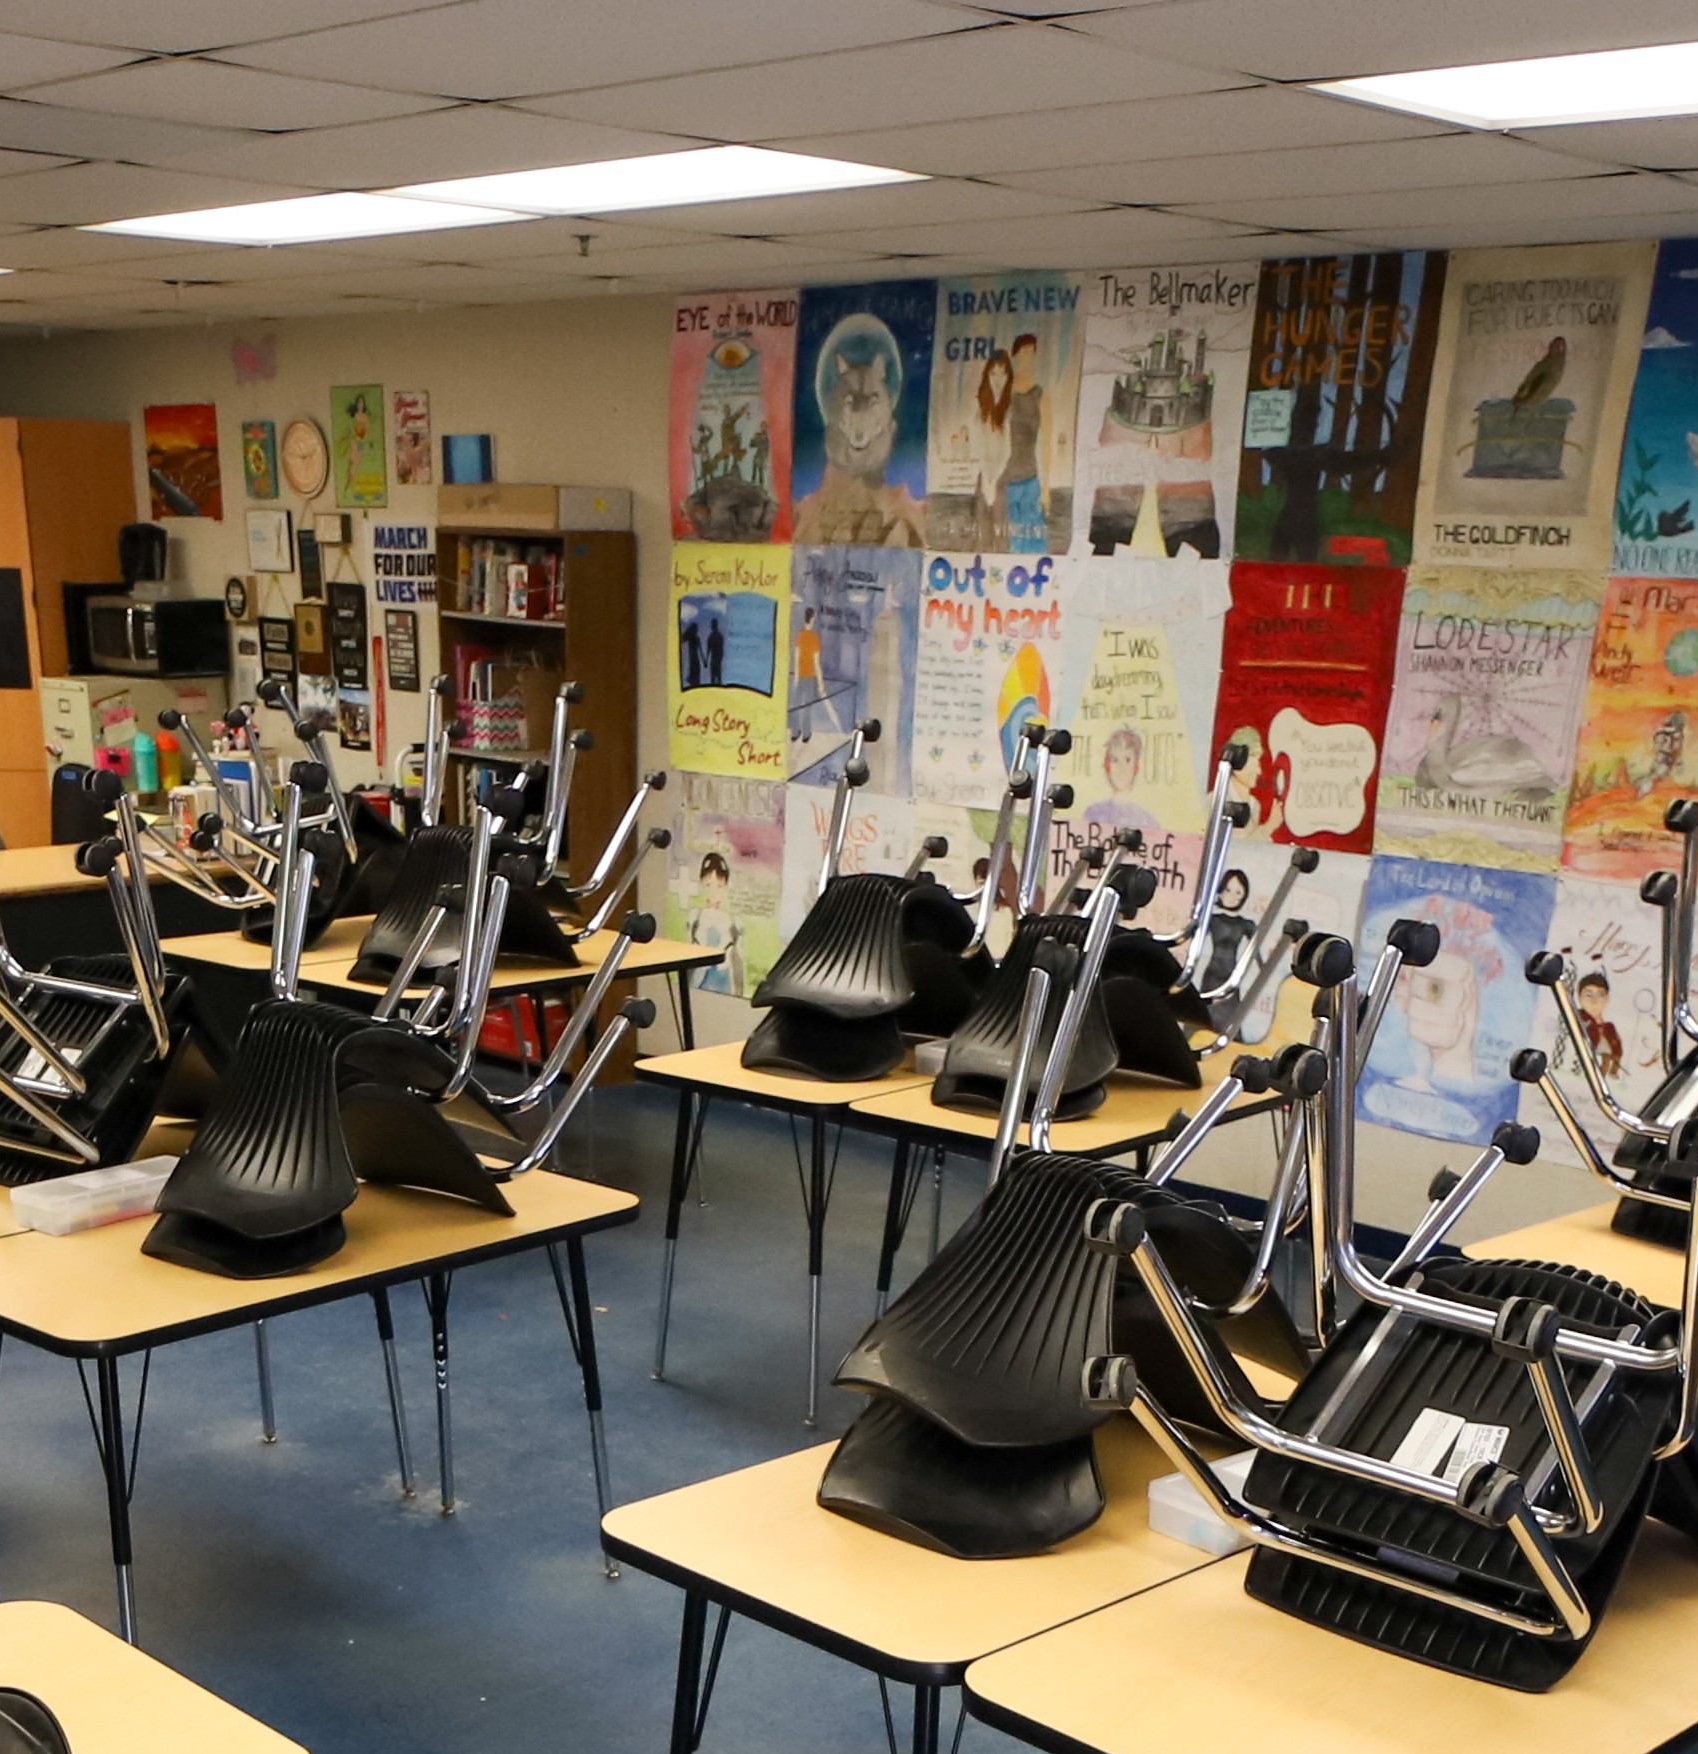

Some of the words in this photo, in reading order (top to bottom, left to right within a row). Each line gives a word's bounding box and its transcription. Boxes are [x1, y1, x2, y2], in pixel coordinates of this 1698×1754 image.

[1098, 273, 1137, 308] The
[1148, 269, 1256, 308] Bellmaker
[1269, 261, 1349, 305] THE
[675, 306, 711, 334] EYE
[716, 305, 735, 328] of
[736, 304, 755, 327] the
[755, 299, 799, 328] WORLD
[948, 287, 1019, 317] BRAVE
[1020, 285, 1081, 314] NEW
[1263, 303, 1414, 348] HUNGER
[944, 335, 1001, 364] GIRL
[1260, 345, 1385, 388] GAMES
[374, 526, 428, 550] MARCH
[1432, 522, 1467, 545] THE
[1468, 523, 1572, 547] GOLDFINCH
[374, 554, 403, 576] FOR
[406, 554, 437, 576] OUR
[674, 562, 691, 592] by
[928, 553, 987, 598] Out
[1007, 556, 1054, 598] of
[375, 580, 417, 603] LIVES
[923, 598, 976, 652] my
[983, 597, 1063, 641] heart
[1412, 609, 1579, 660] LODESTAR
[1127, 635, 1159, 660] was
[1409, 653, 1465, 675] SHANNON
[1467, 655, 1545, 678] MESSENGER
[675, 704, 709, 734] Long
[710, 707, 752, 740] Story
[1140, 694, 1155, 721] I
[737, 740, 784, 768] Short
[1402, 786, 1429, 808] THIS
[1447, 791, 1487, 816] WHAT
[1492, 798, 1526, 822] THEY
[1052, 819, 1085, 851] The
[1152, 833, 1176, 865] of
[1416, 867, 1452, 892] Lord
